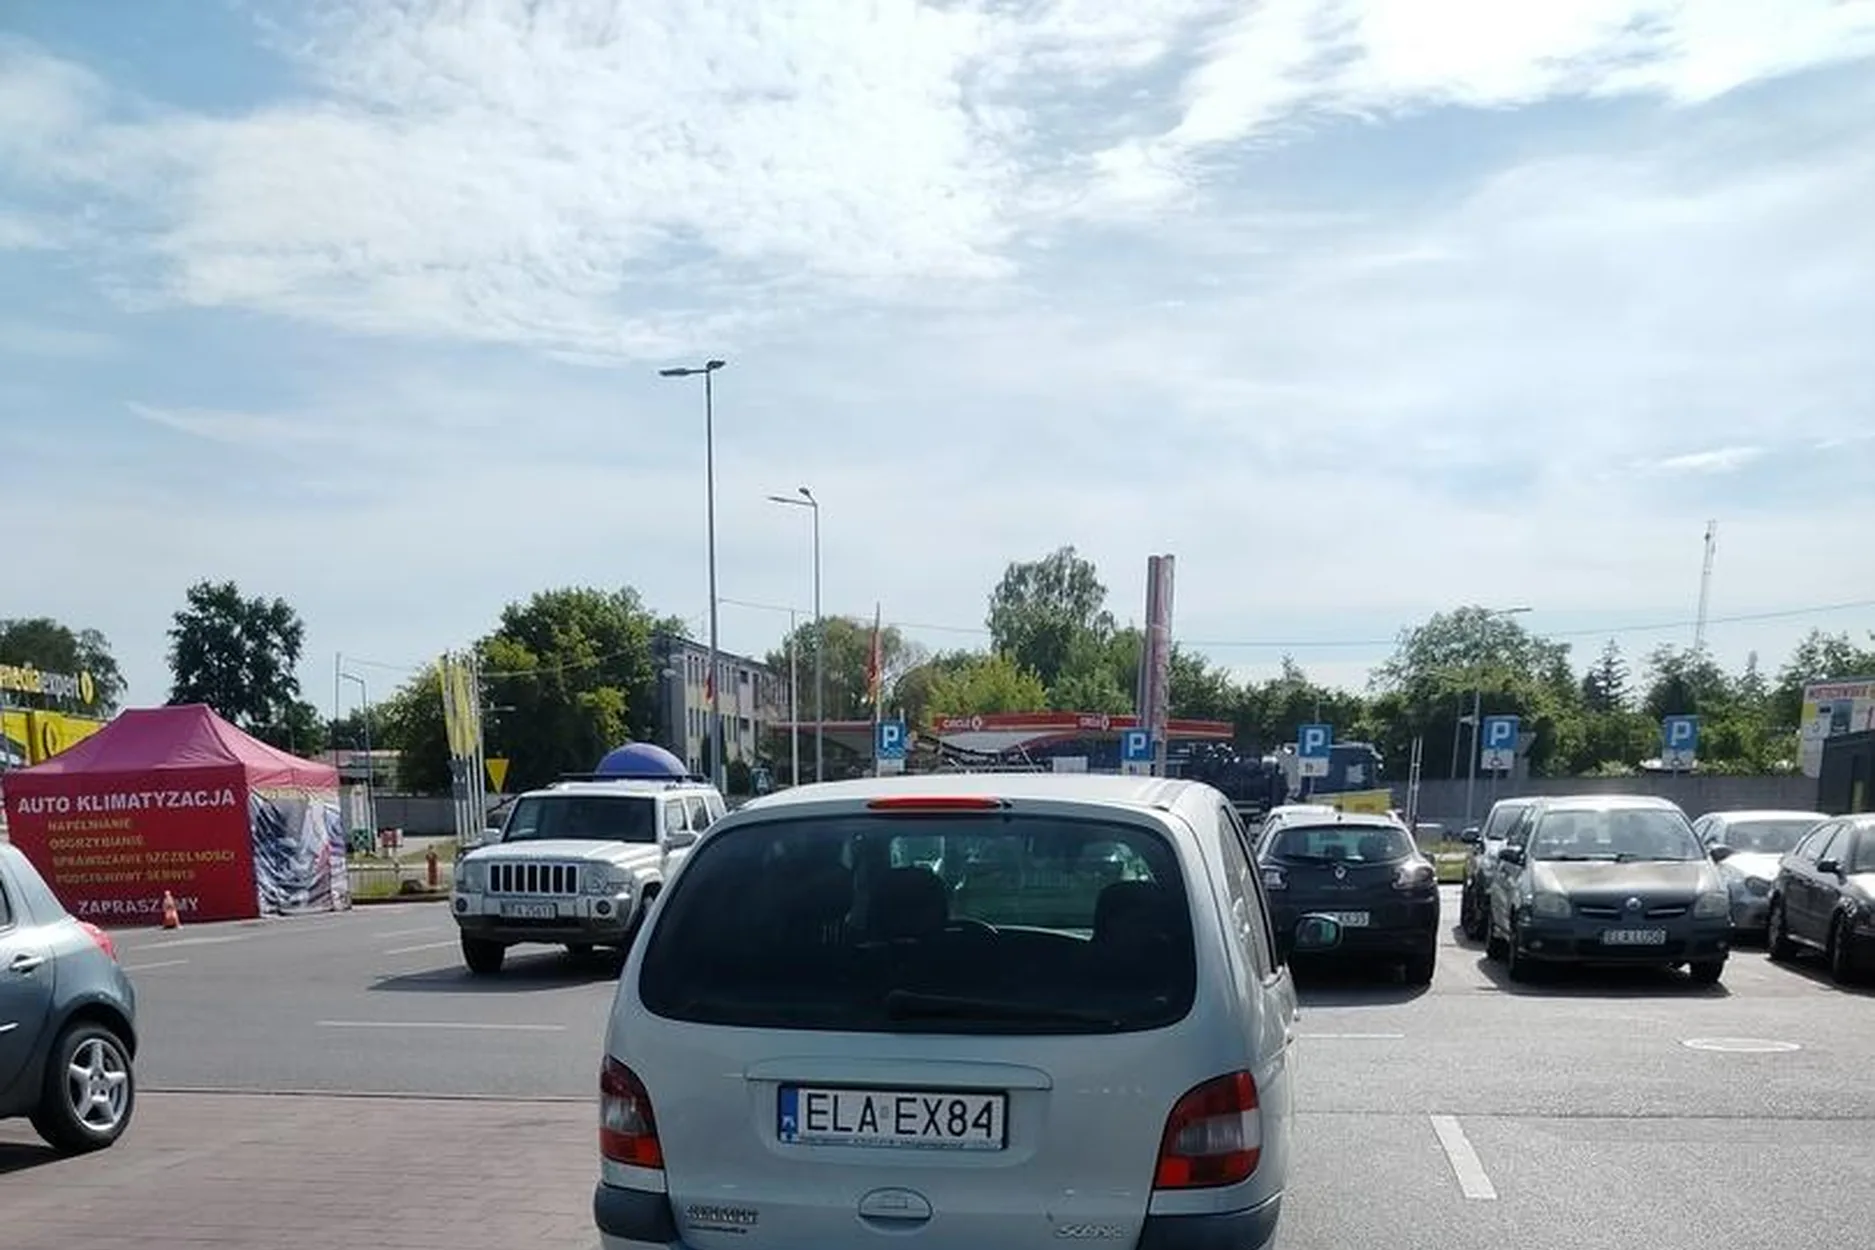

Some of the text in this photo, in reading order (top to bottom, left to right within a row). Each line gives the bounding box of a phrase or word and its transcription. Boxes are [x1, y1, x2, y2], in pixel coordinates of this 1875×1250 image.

[883, 725, 899, 748] P
[1129, 734, 1146, 757] P
[1306, 729, 1324, 754] P
[1490, 721, 1511, 746] P
[1671, 721, 1691, 746] P
[17, 788, 236, 814] AUTO KLIMATYZACJA
[77, 897, 199, 916] ZAPRASZMY
[806, 1092, 994, 1139] ELA EX84
